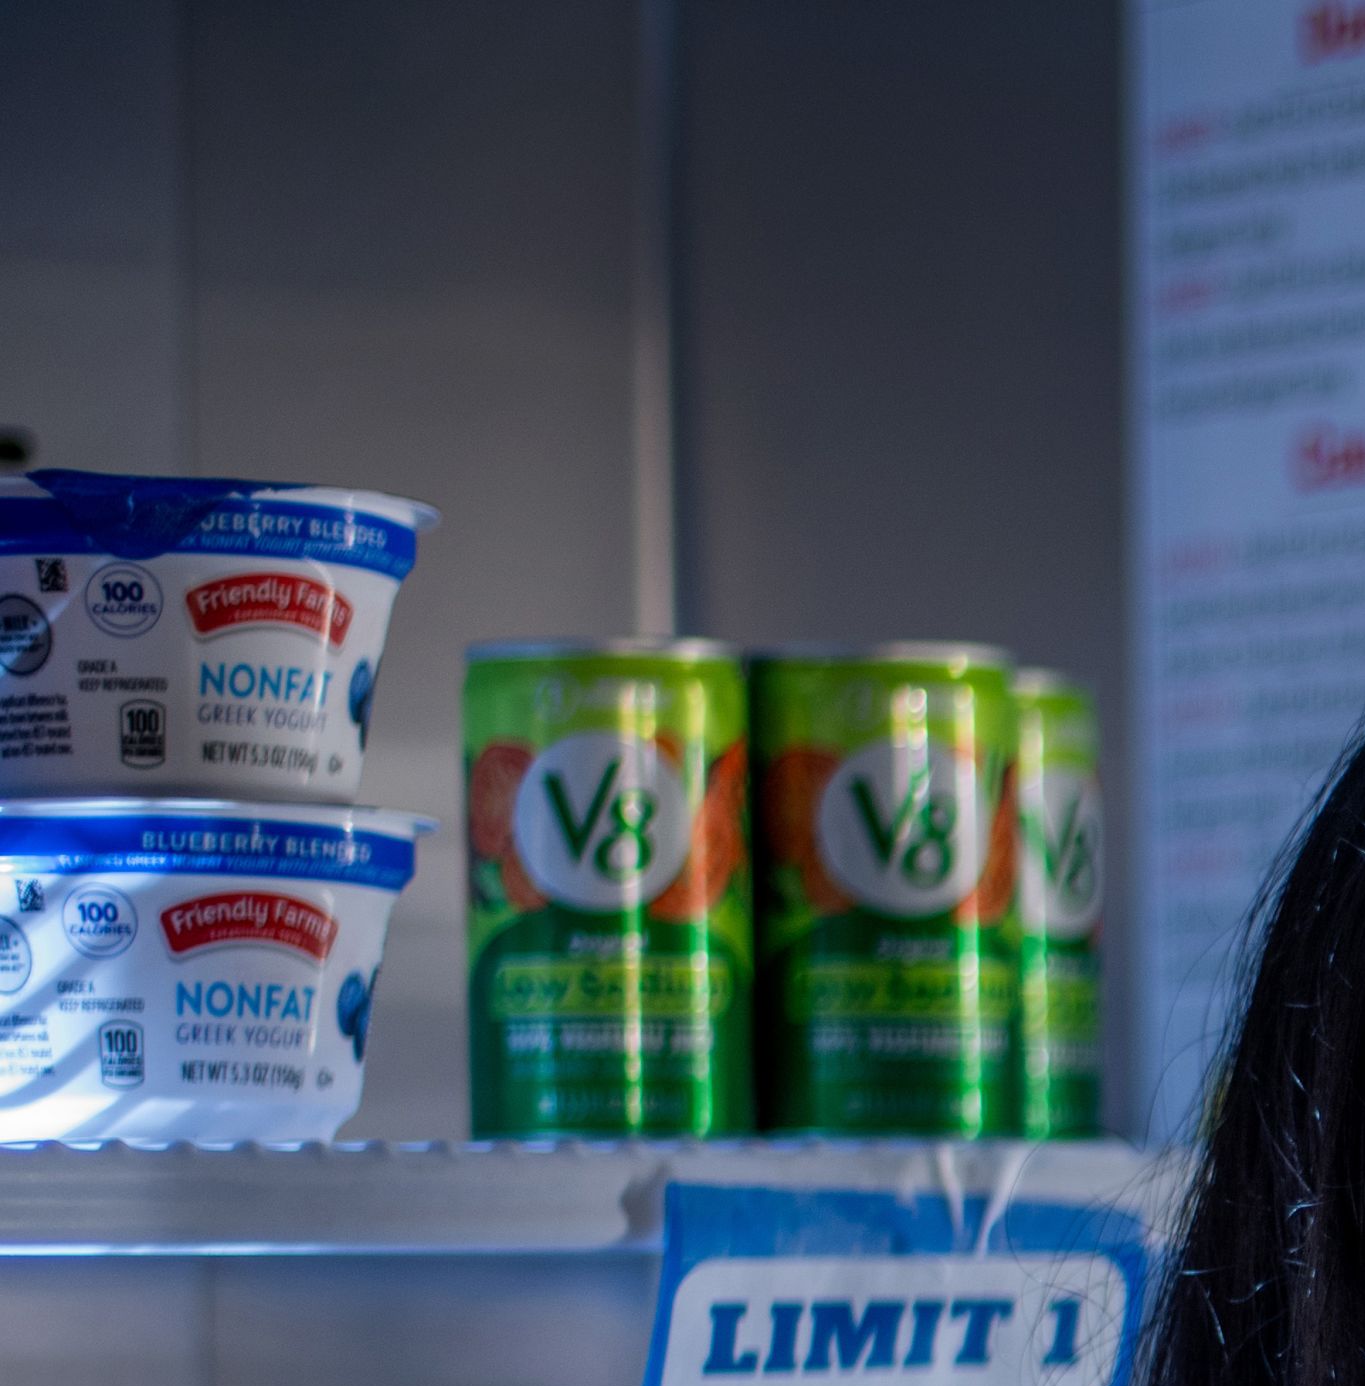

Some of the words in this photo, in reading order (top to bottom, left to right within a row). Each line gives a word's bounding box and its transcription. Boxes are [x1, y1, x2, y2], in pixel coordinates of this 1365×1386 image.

[102, 581, 144, 602] 100
[199, 578, 291, 616] Friendly
[92, 603, 157, 616] CALORIES
[200, 661, 333, 706] NONFAT
[127, 709, 160, 733] 100
[198, 703, 256, 729] GREEK
[203, 739, 225, 764] NET
[228, 741, 248, 767] WT
[543, 756, 656, 887] V8
[848, 762, 959, 889] V8
[142, 831, 279, 853] BLUEBERRY
[78, 902, 119, 923] 100
[171, 896, 268, 935] Friendly
[275, 900, 332, 938] Farms
[69, 923, 131, 936] CALORIES
[175, 980, 316, 1022] NONFAT
[105, 1029, 137, 1053] 100
[175, 1023, 236, 1046] GREEK
[182, 1060, 205, 1083] NET
[207, 1060, 228, 1084] WT
[231, 1061, 250, 1085] 5.3
[252, 1061, 269, 1086] OZ
[702, 1300, 1014, 1376] LIMIT
[1041, 1298, 1083, 1366] 1
